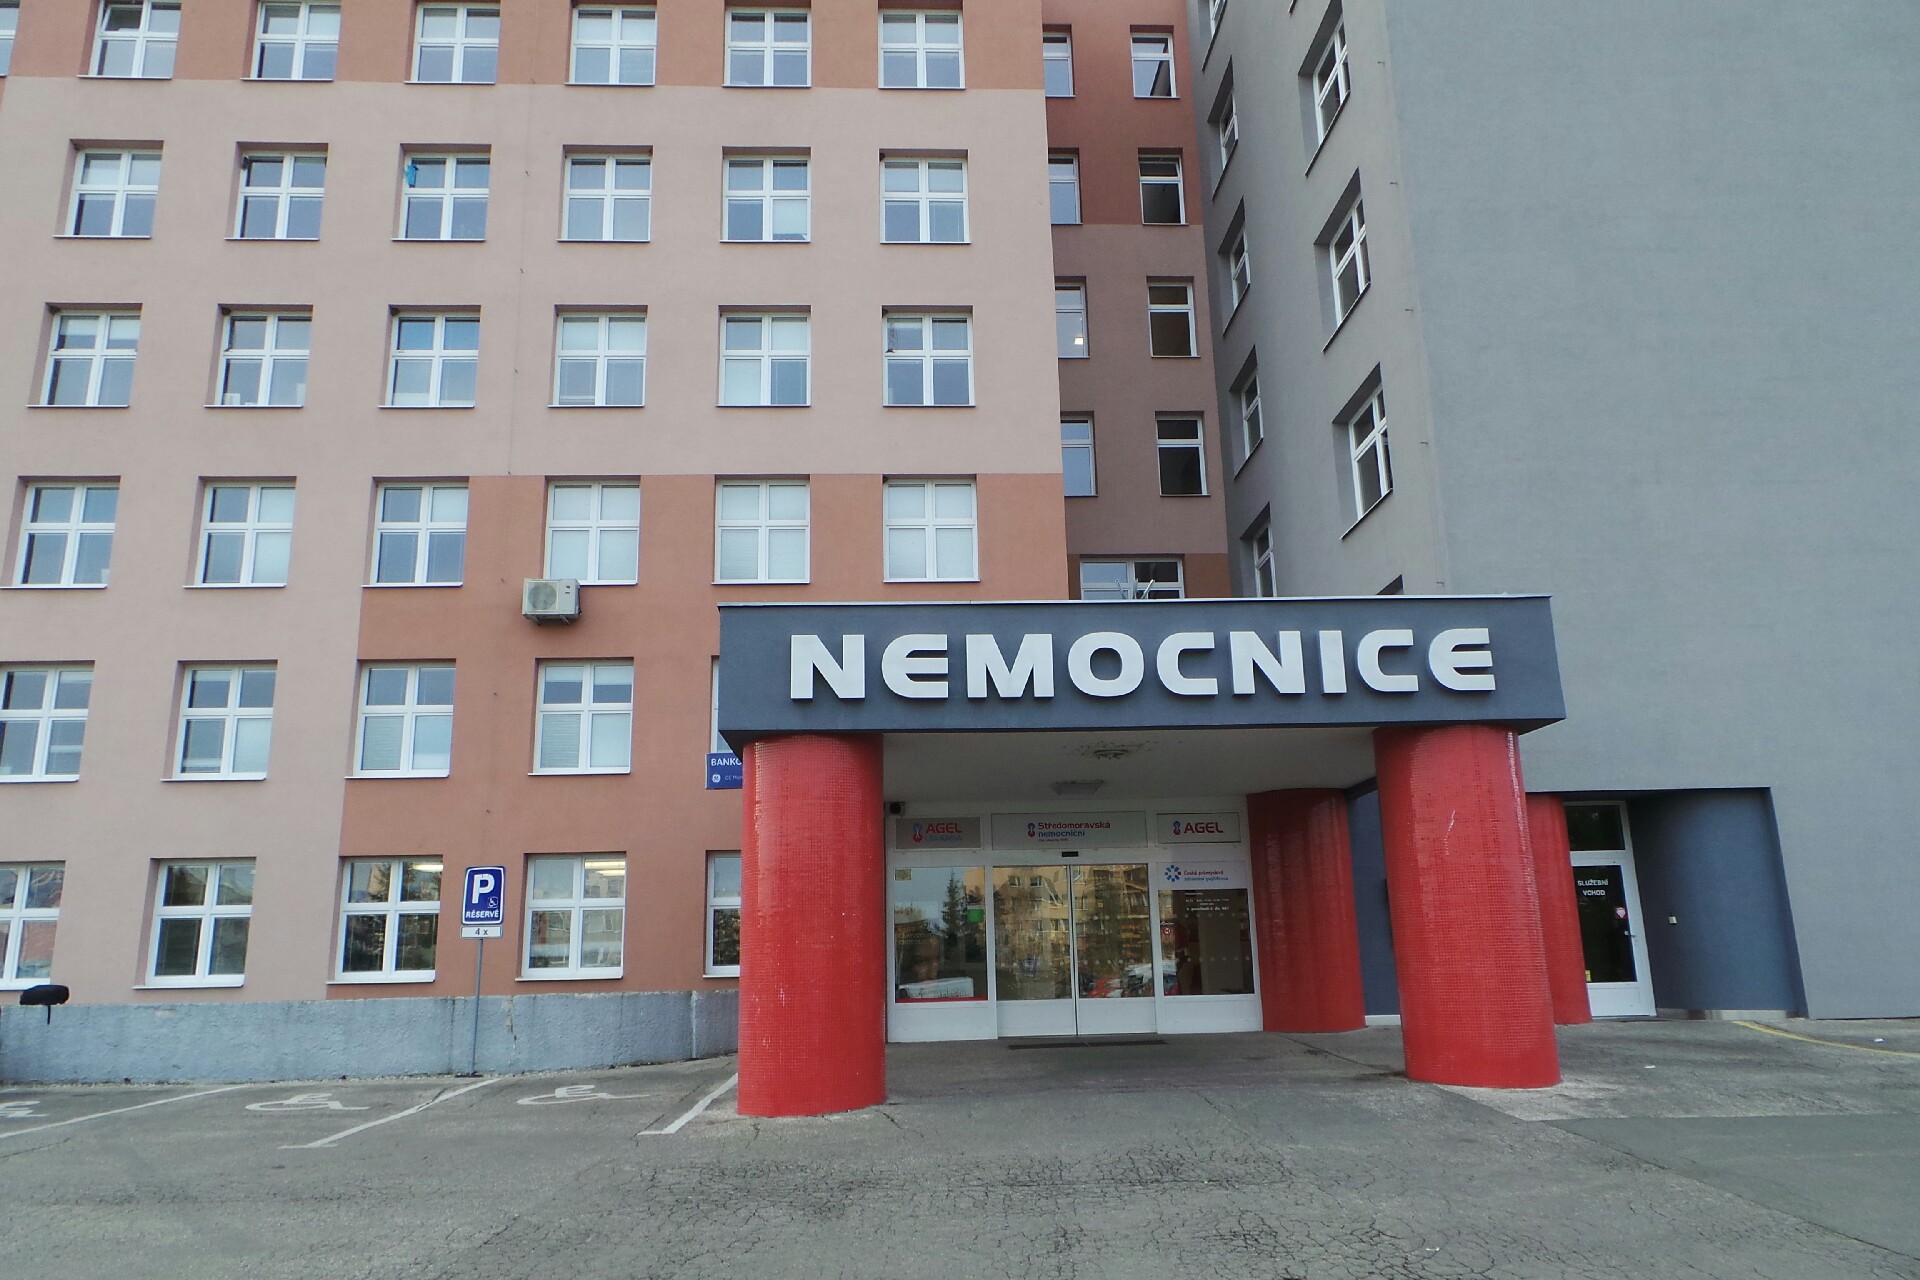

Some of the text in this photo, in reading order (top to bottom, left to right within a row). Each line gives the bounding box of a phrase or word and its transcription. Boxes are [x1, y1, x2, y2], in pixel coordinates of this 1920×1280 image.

[789, 627, 1497, 699] NEMOCNICE
[925, 822, 962, 834] AGEL
[1184, 822, 1223, 834] AGEL
[471, 873, 495, 904] P
[474, 927, 480, 936] 4
